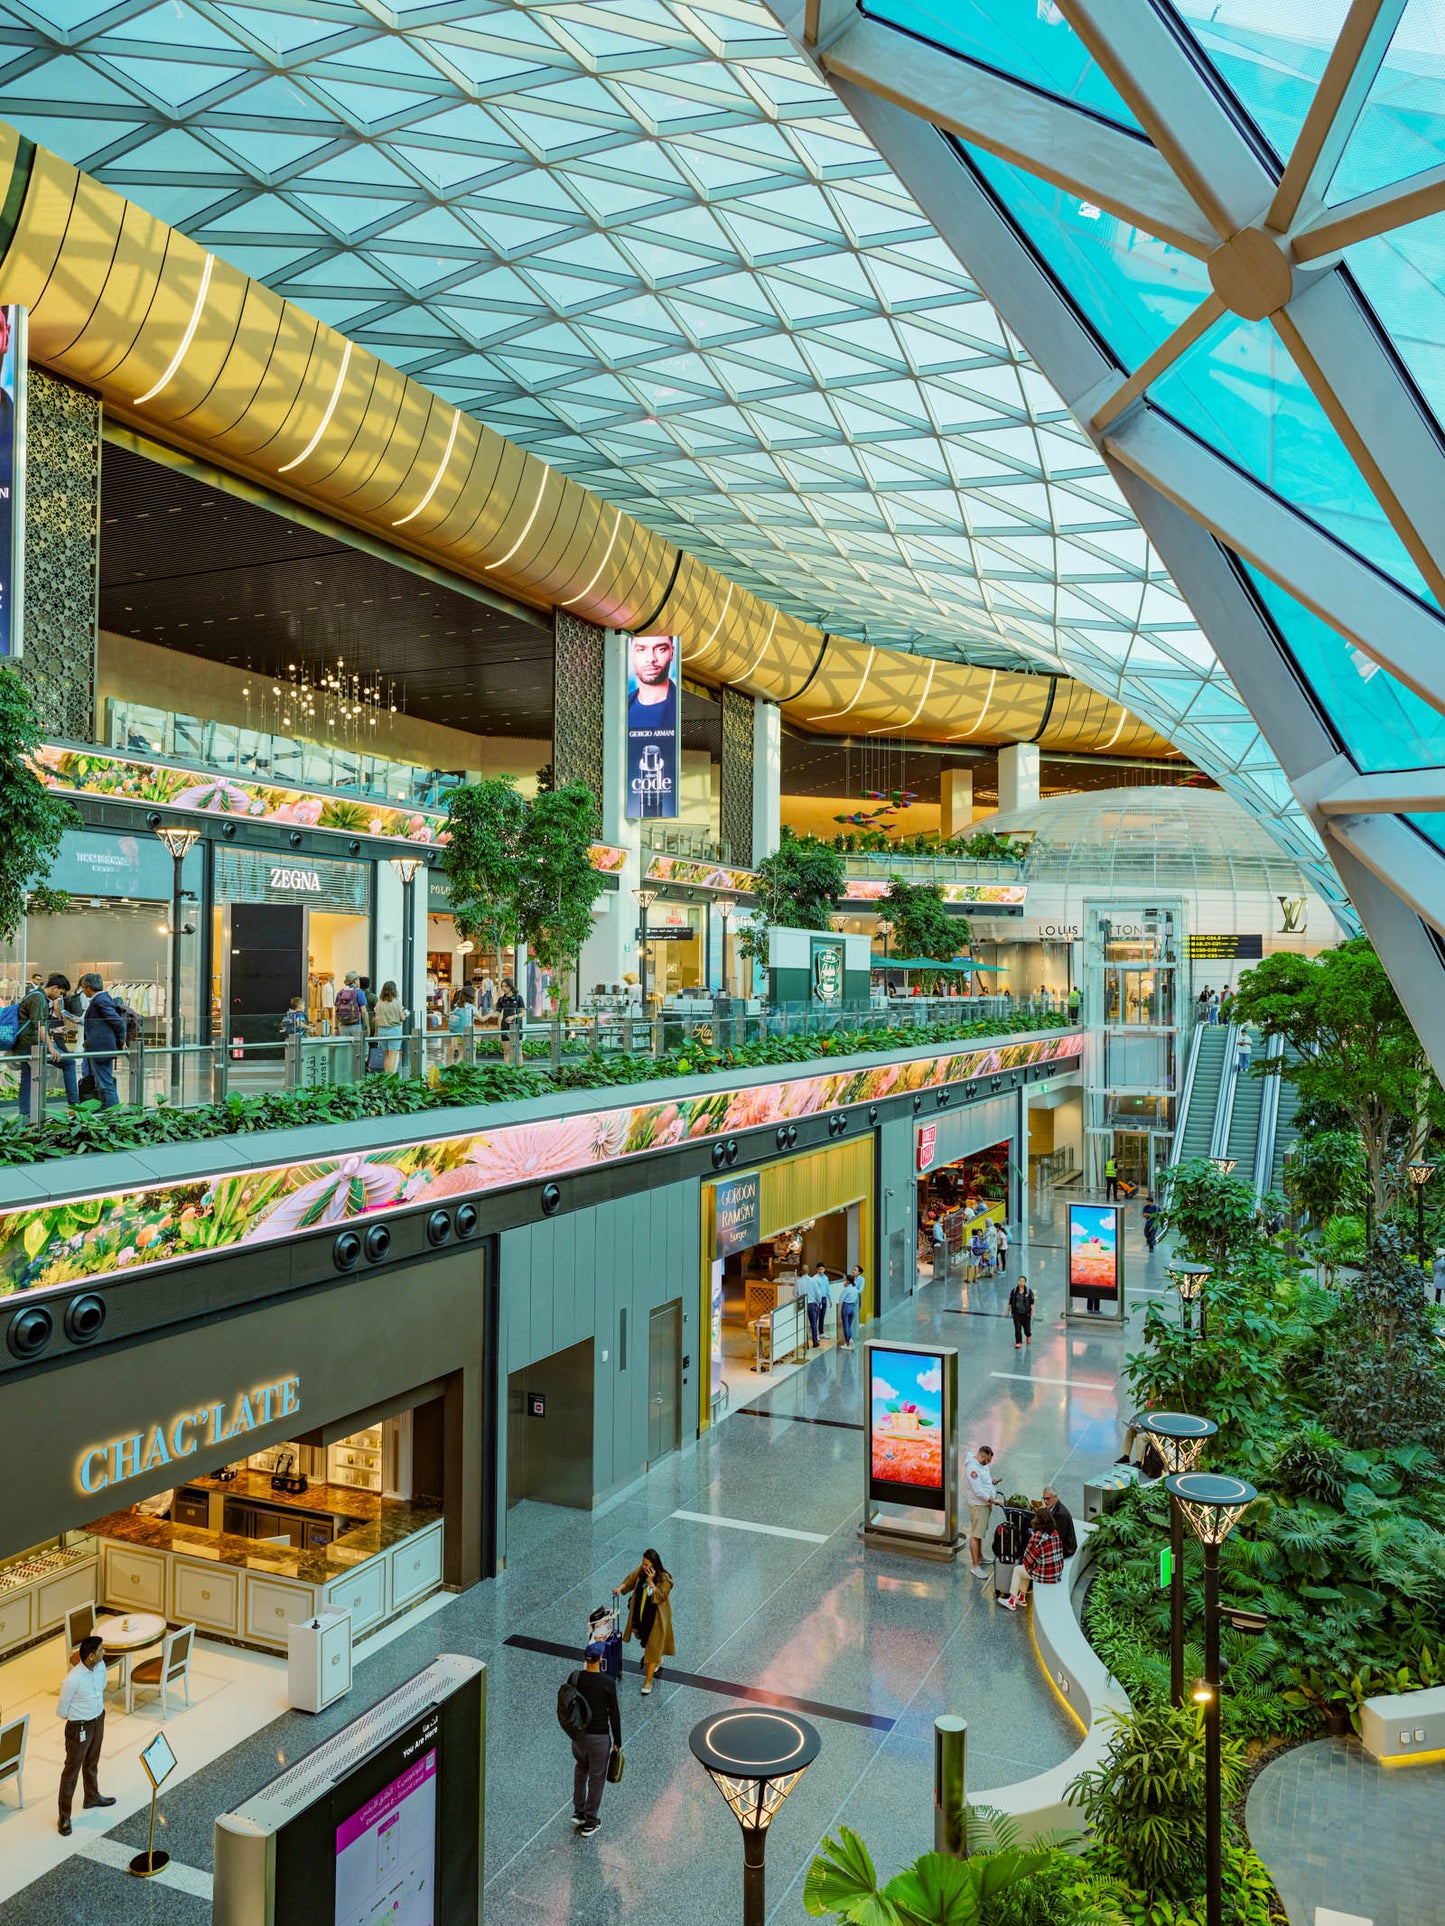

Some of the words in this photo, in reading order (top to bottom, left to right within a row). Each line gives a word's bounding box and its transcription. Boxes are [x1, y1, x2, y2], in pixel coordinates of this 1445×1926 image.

[629, 730, 652, 738] GIORGIO
[631, 770, 672, 791] code
[270, 868, 321, 891] ZEGNA
[1038, 925, 1078, 936] LOUIS
[721, 1182, 756, 1206] GORDON
[722, 1203, 755, 1228] RAMSAY
[729, 1229, 747, 1243] burger
[81, 1377, 300, 1493] CHAC'LATE
[403, 1745, 415, 1758] You
[415, 1737, 425, 1750] Are
[425, 1726, 438, 1741] Here
